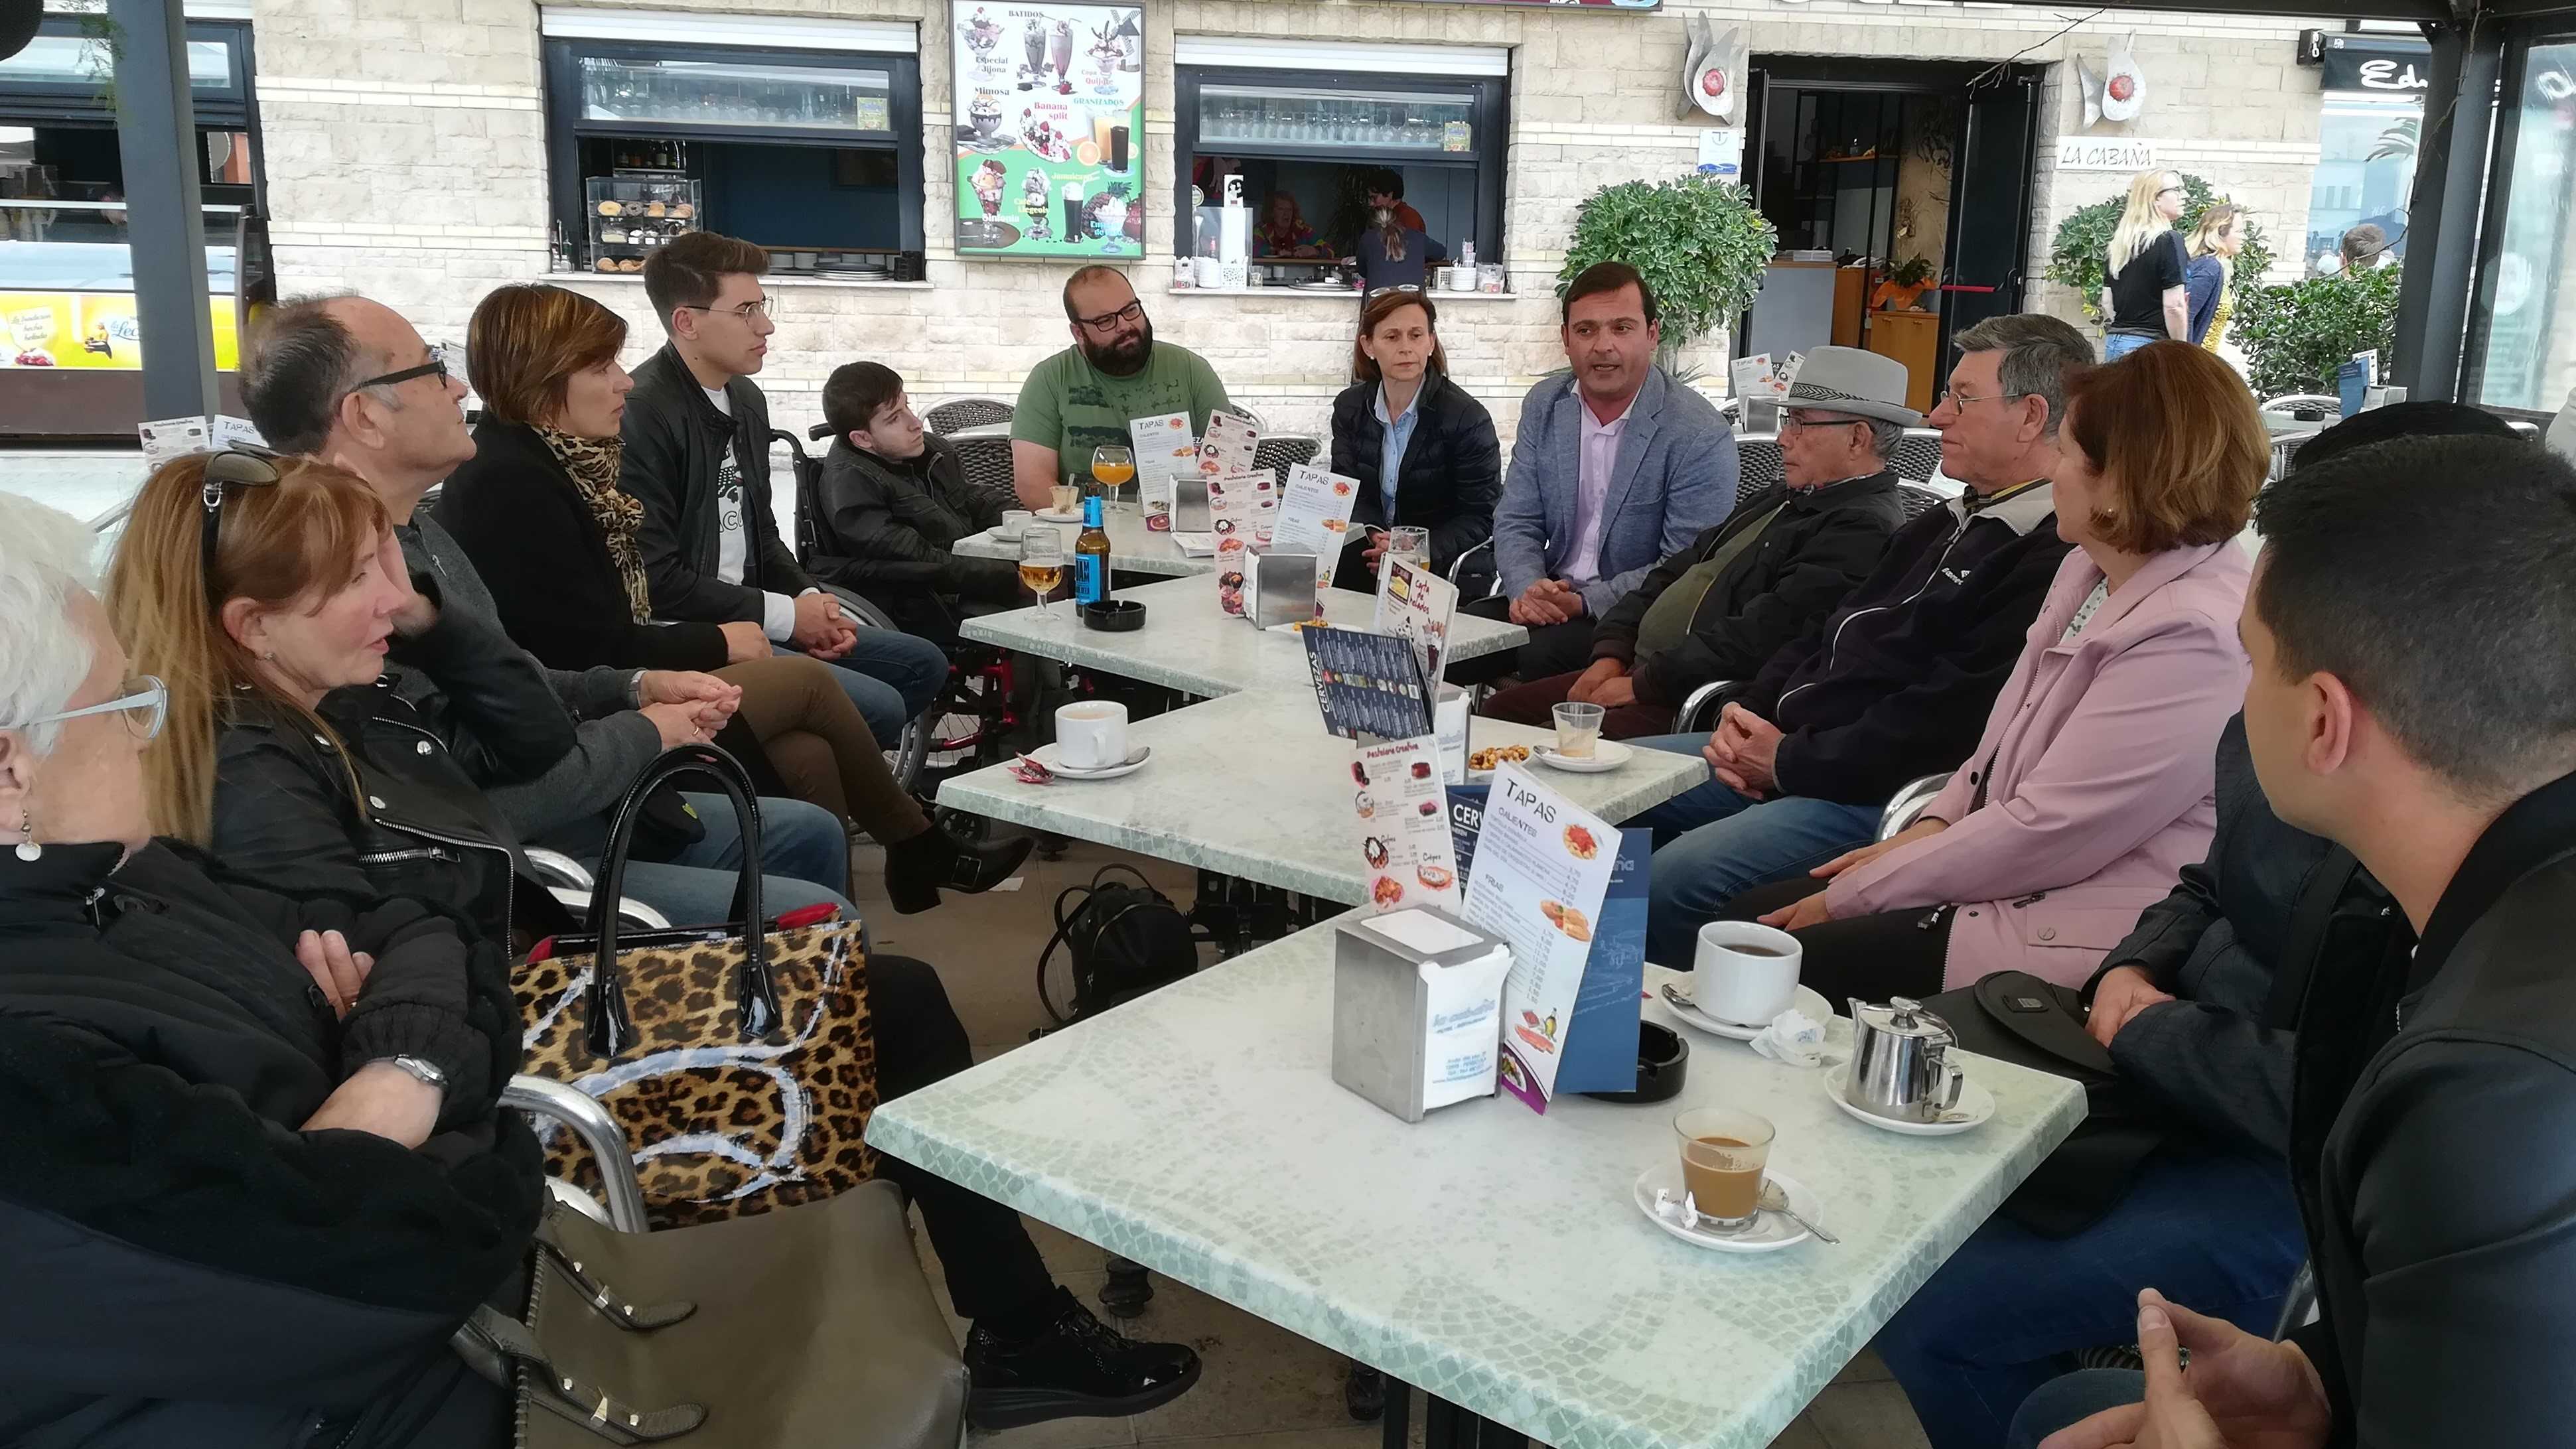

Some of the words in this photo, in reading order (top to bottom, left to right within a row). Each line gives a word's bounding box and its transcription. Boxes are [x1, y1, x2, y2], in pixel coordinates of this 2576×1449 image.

[2062, 146, 2081, 165] LA
[2086, 142, 2151, 166] CABAÑA
[224, 421, 256, 434] TAPAS
[1139, 419, 1164, 430] TAPAS
[1300, 470, 1329, 485] TAPAS
[1415, 579, 1429, 594] Carta
[1417, 592, 1424, 601] de
[1309, 652, 1329, 713] CERVEZAS
[1507, 778, 1556, 823] TAPAS
[1498, 807, 1538, 837] CALIENTES
